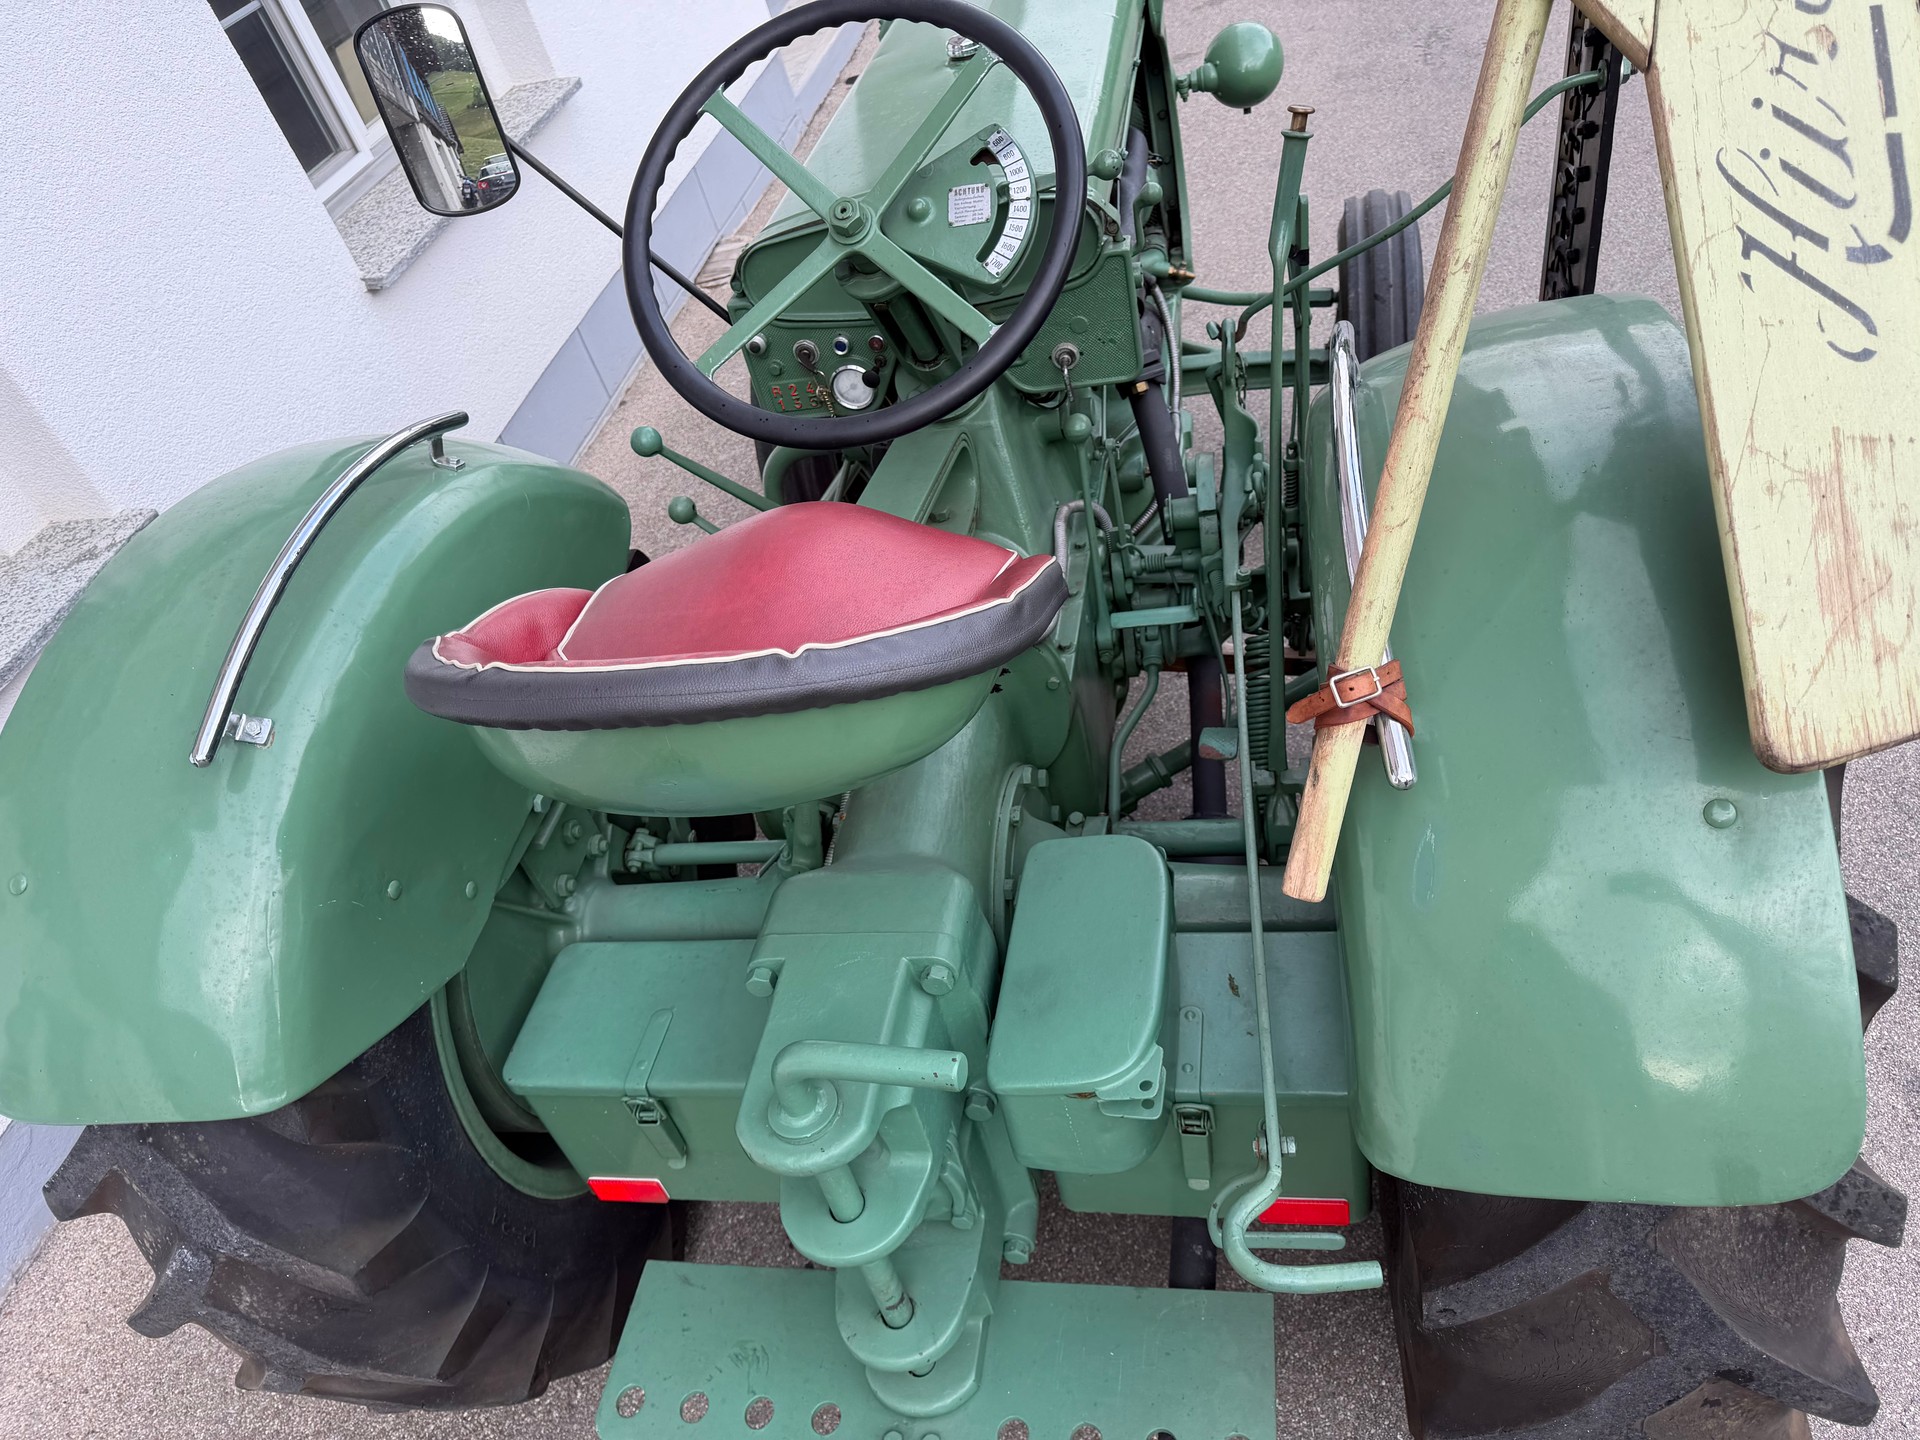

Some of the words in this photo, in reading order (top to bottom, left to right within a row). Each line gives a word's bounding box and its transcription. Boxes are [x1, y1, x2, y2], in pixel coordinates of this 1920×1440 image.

[992, 136, 1004, 148] 600
[1002, 150, 1015, 161] 800
[1009, 166, 1024, 176] 1000
[1013, 186, 1028, 194] 1200
[1013, 205, 1028, 213] 1400
[1008, 223, 1023, 233] 1500
[1001, 241, 1016, 252] 1600
[989, 257, 1003, 270] 1700
[788, 384, 798, 396] 2
[806, 382, 815, 394] 4
[778, 398, 786, 410] 1
